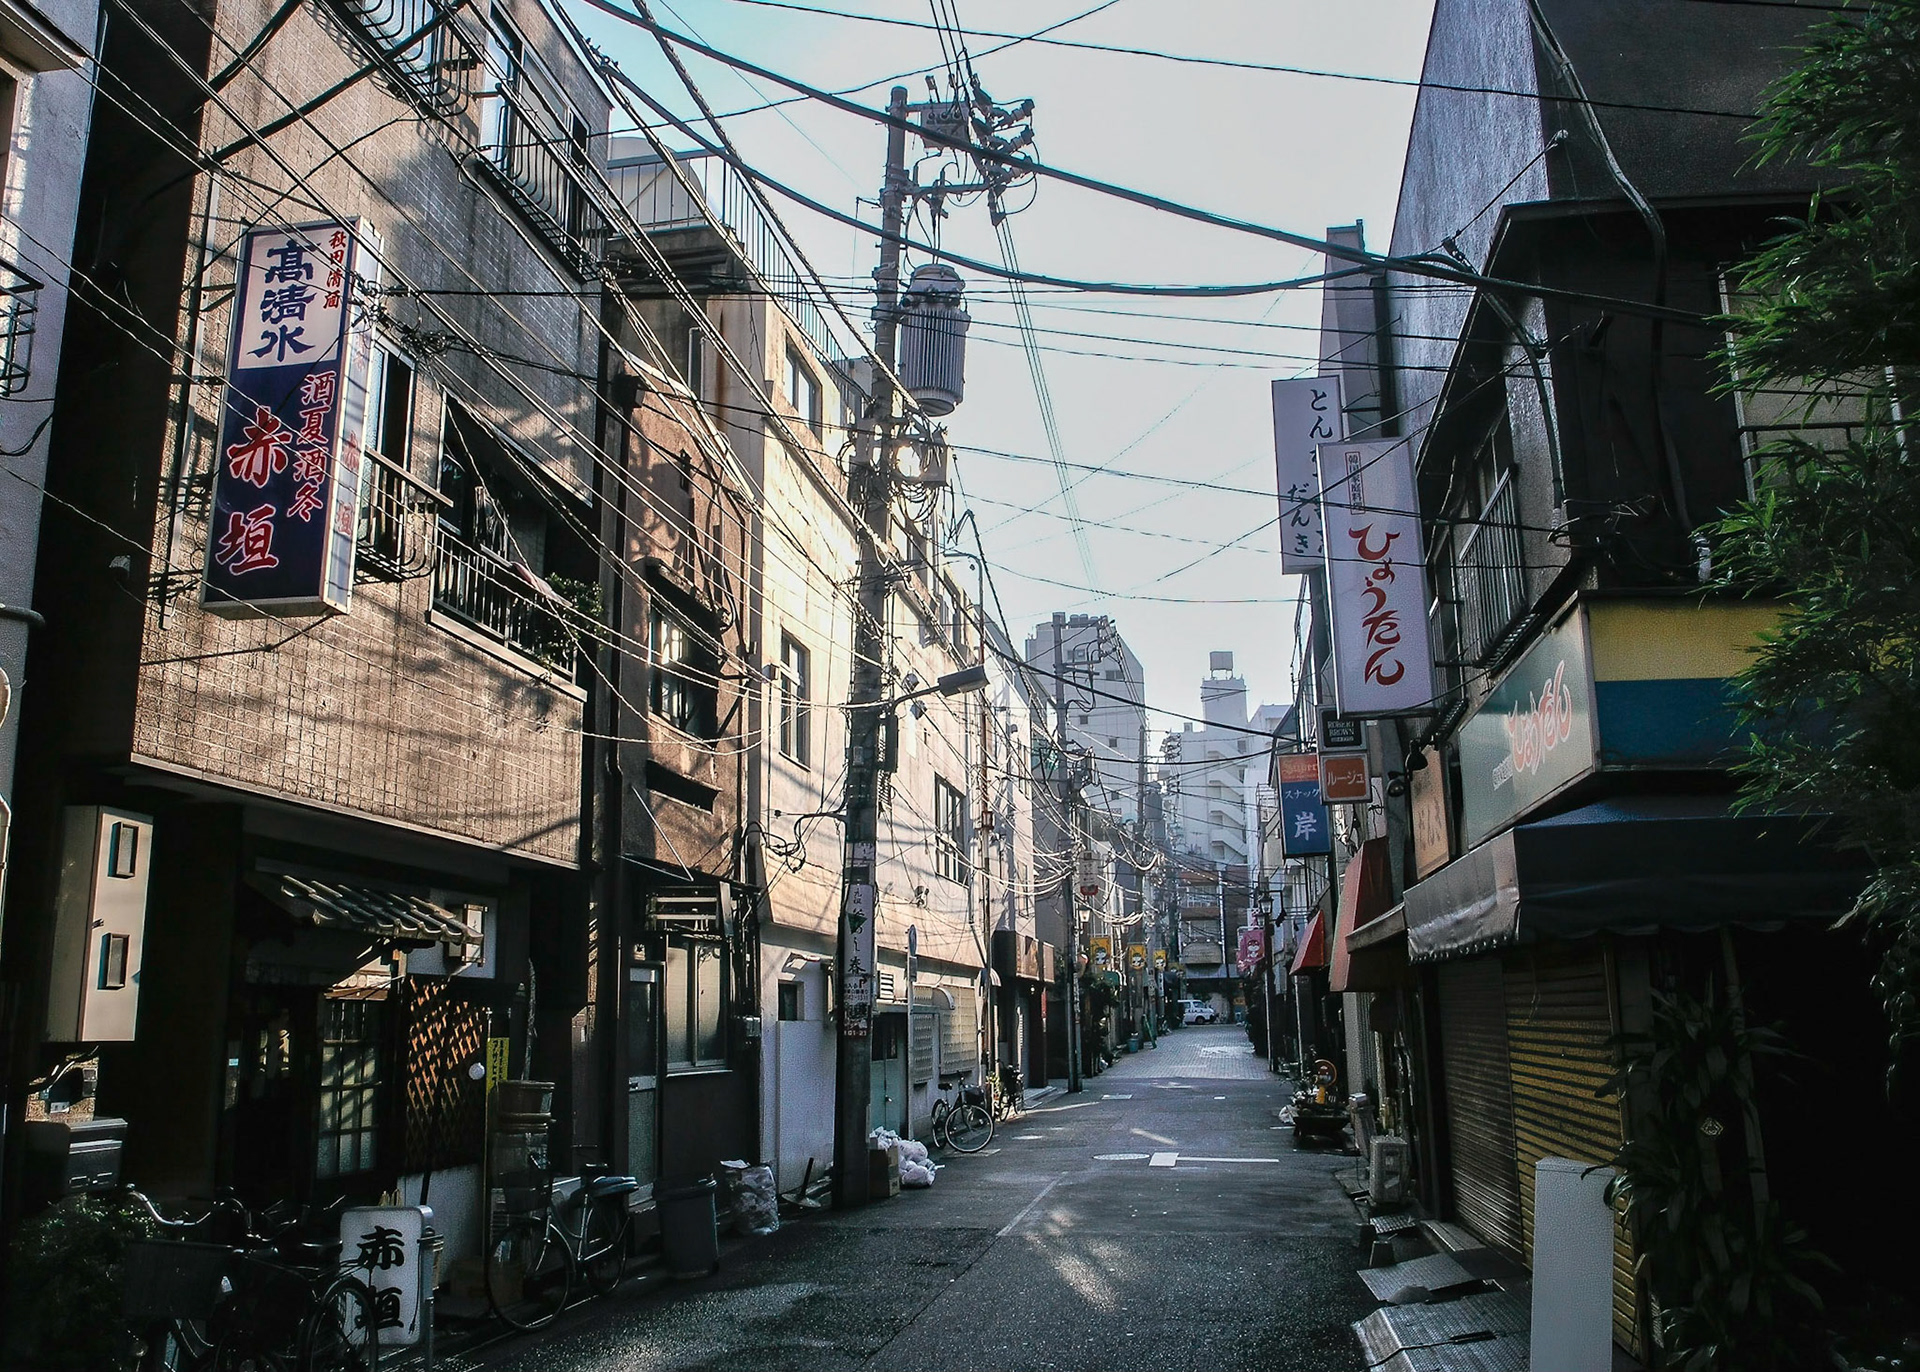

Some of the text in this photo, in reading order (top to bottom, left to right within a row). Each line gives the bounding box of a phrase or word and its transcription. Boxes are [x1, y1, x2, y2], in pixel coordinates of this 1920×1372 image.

[215, 405, 293, 576] 赤垣
[287, 371, 336, 522] 酒夏酒冬
[1348, 523, 1405, 685] ひょうたん
[1285, 788, 1320, 800] スナック
[1294, 811, 1317, 841] 岸
[1327, 771, 1365, 786] ルージュ
[356, 1225, 405, 1329] 赤垣
